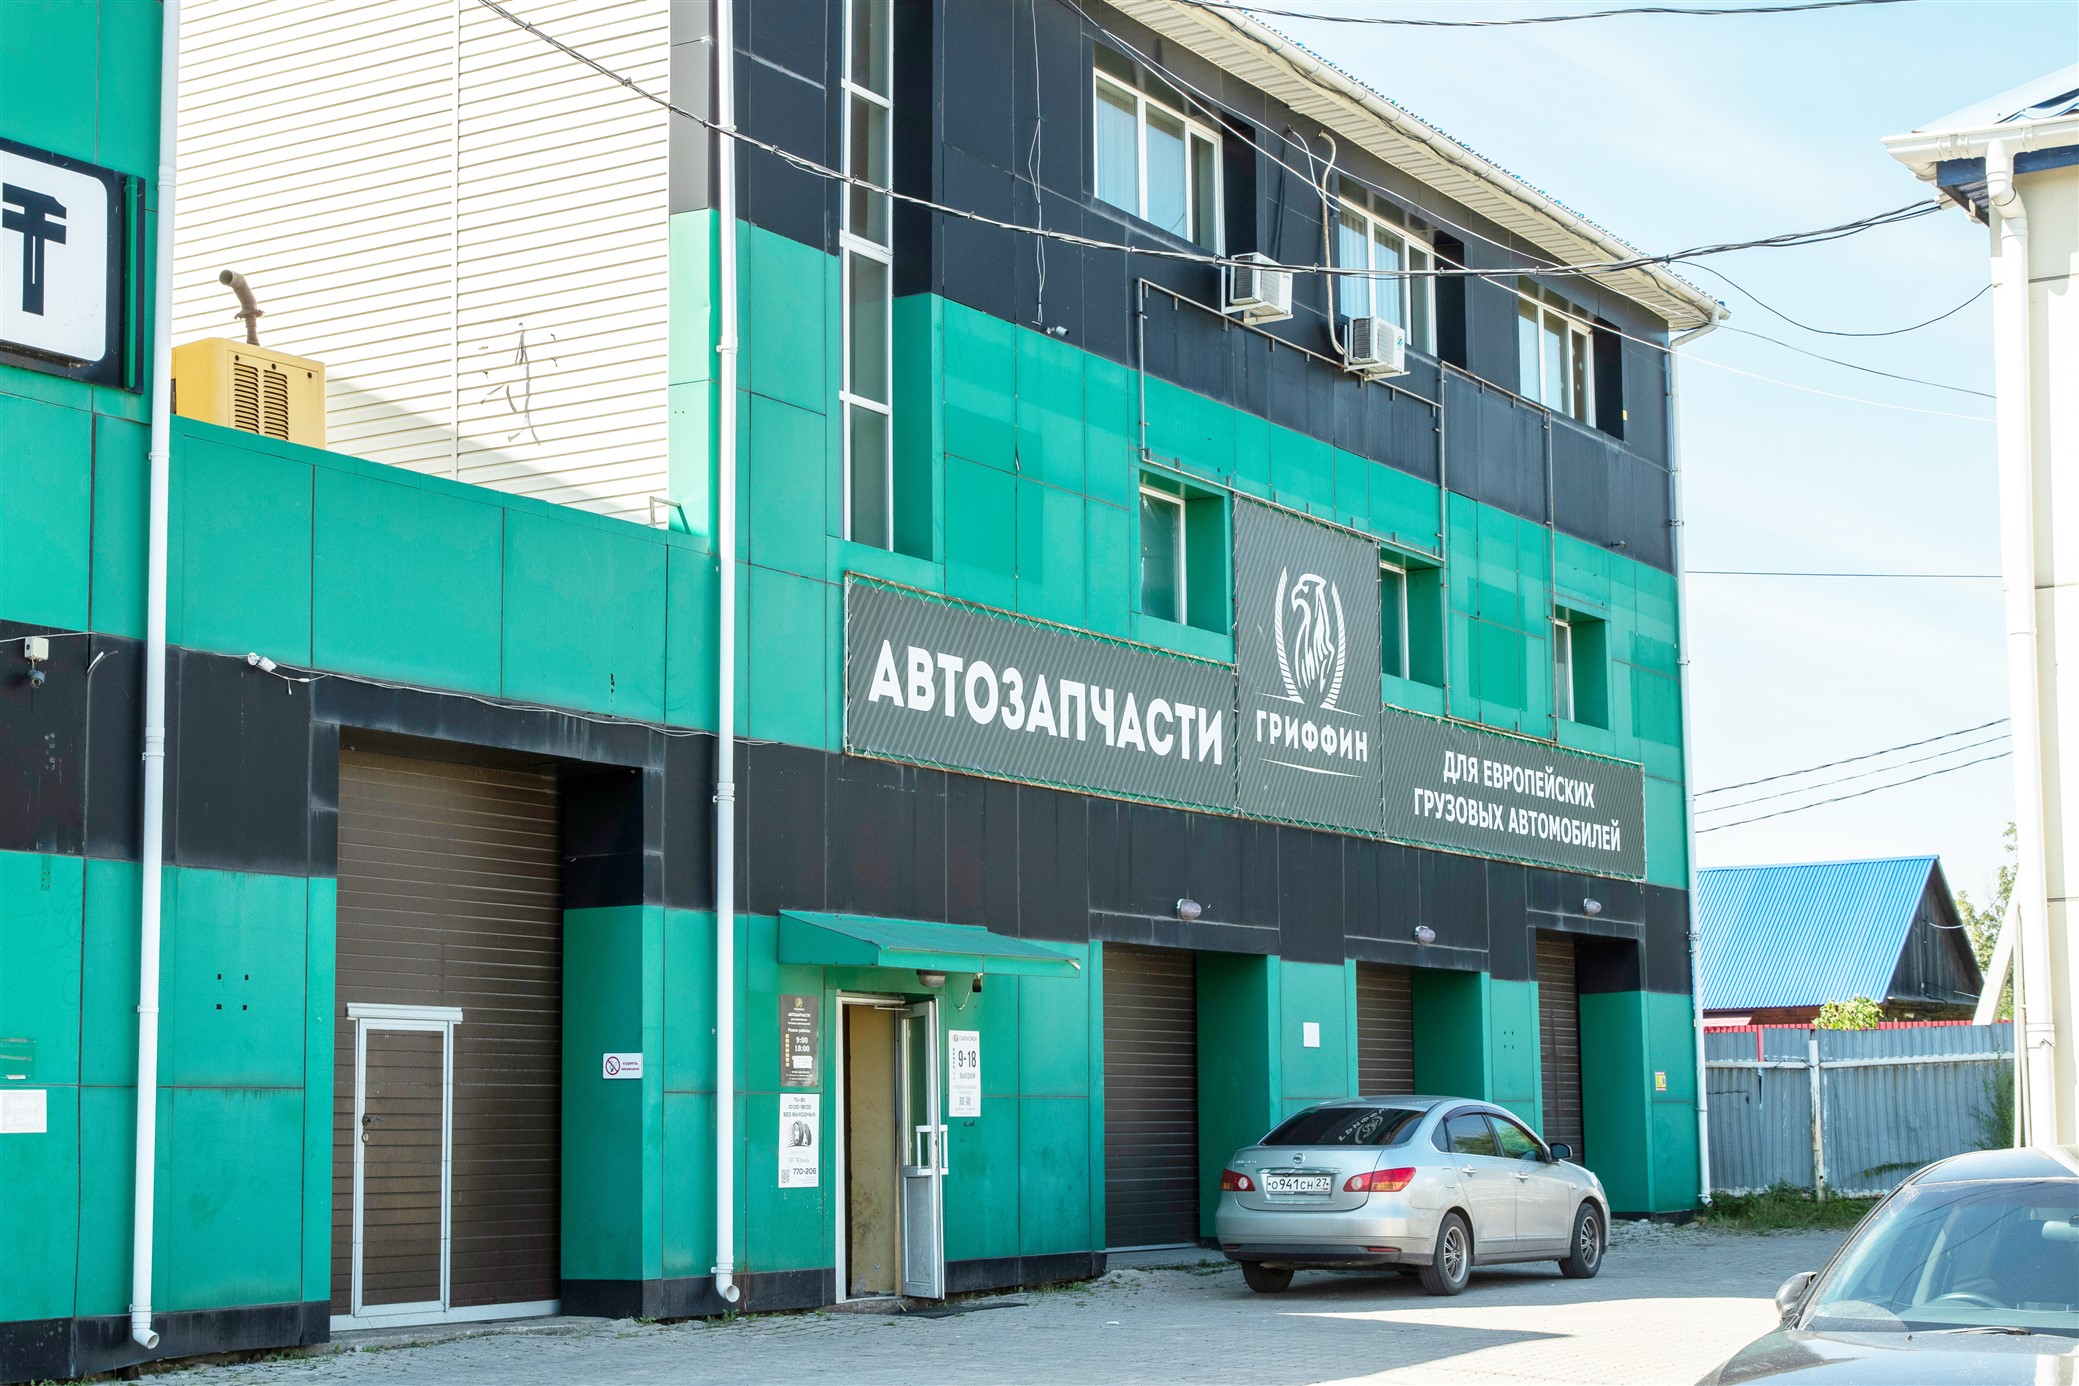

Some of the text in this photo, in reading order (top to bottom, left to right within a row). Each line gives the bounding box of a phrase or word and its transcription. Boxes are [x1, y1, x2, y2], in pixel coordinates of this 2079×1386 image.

[867, 639, 1223, 766] АВТОЗАПЧАСТИ
[1255, 709, 1369, 763] ГРИФФИН
[1443, 749, 1596, 809] ДЛЯ ЕВРОПЕЙСКИХ
[1413, 787, 1621, 852] ГРУЗОВЫХ АВТОМОБИЛЕЙ
[795, 1036, 809, 1044] 9:00
[958, 1050, 977, 1068] 9-18
[792, 1167, 817, 1175] 770-206
[1316, 1178, 1327, 1187] 27
